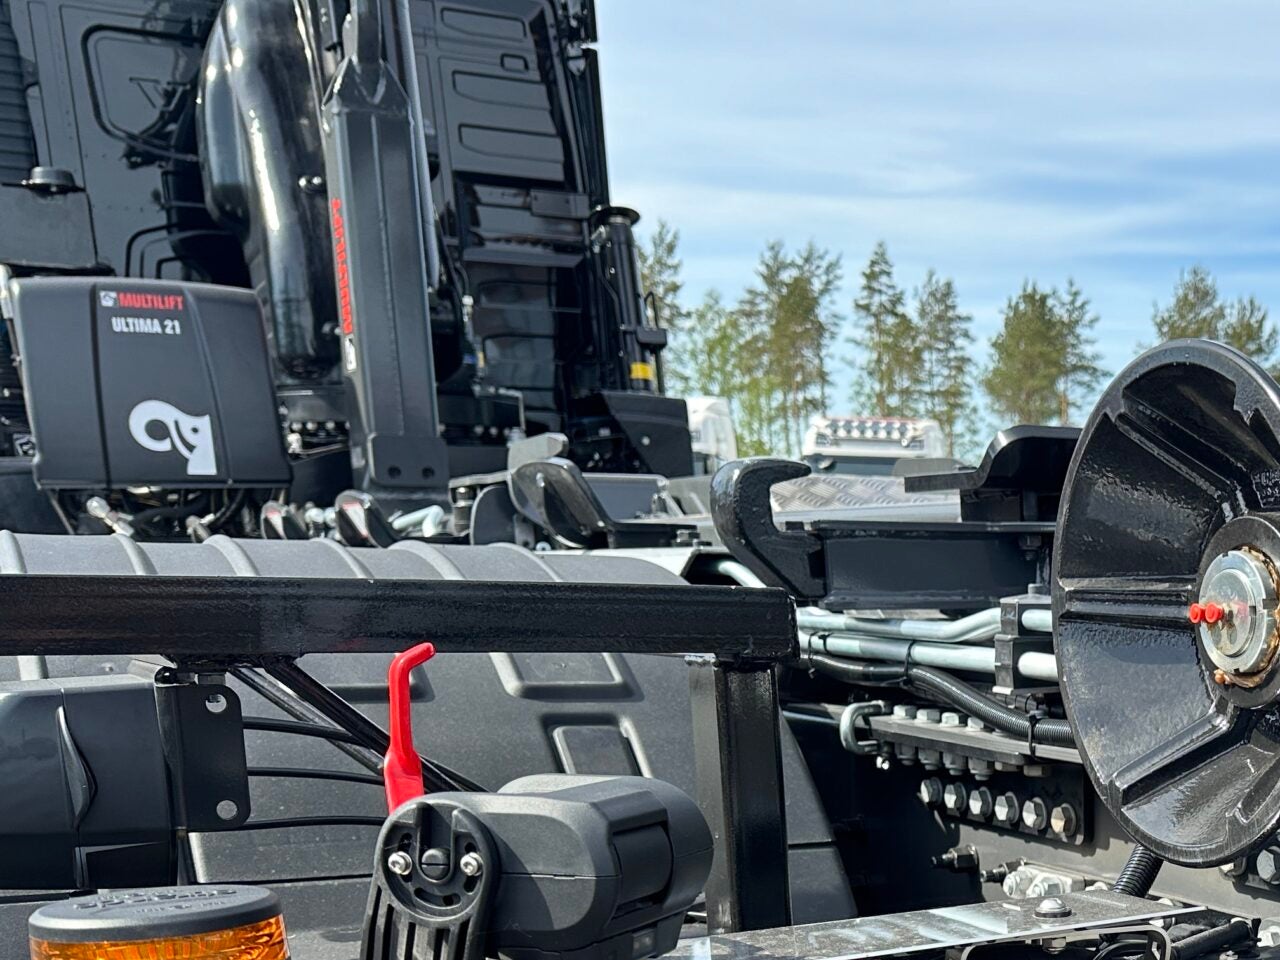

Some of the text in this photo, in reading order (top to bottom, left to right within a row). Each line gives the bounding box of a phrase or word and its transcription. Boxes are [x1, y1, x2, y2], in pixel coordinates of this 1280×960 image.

[331, 198, 353, 335] MULTILIFT
[118, 291, 184, 310] MULTILIFT
[111, 316, 181, 335] ULTIMA 21
